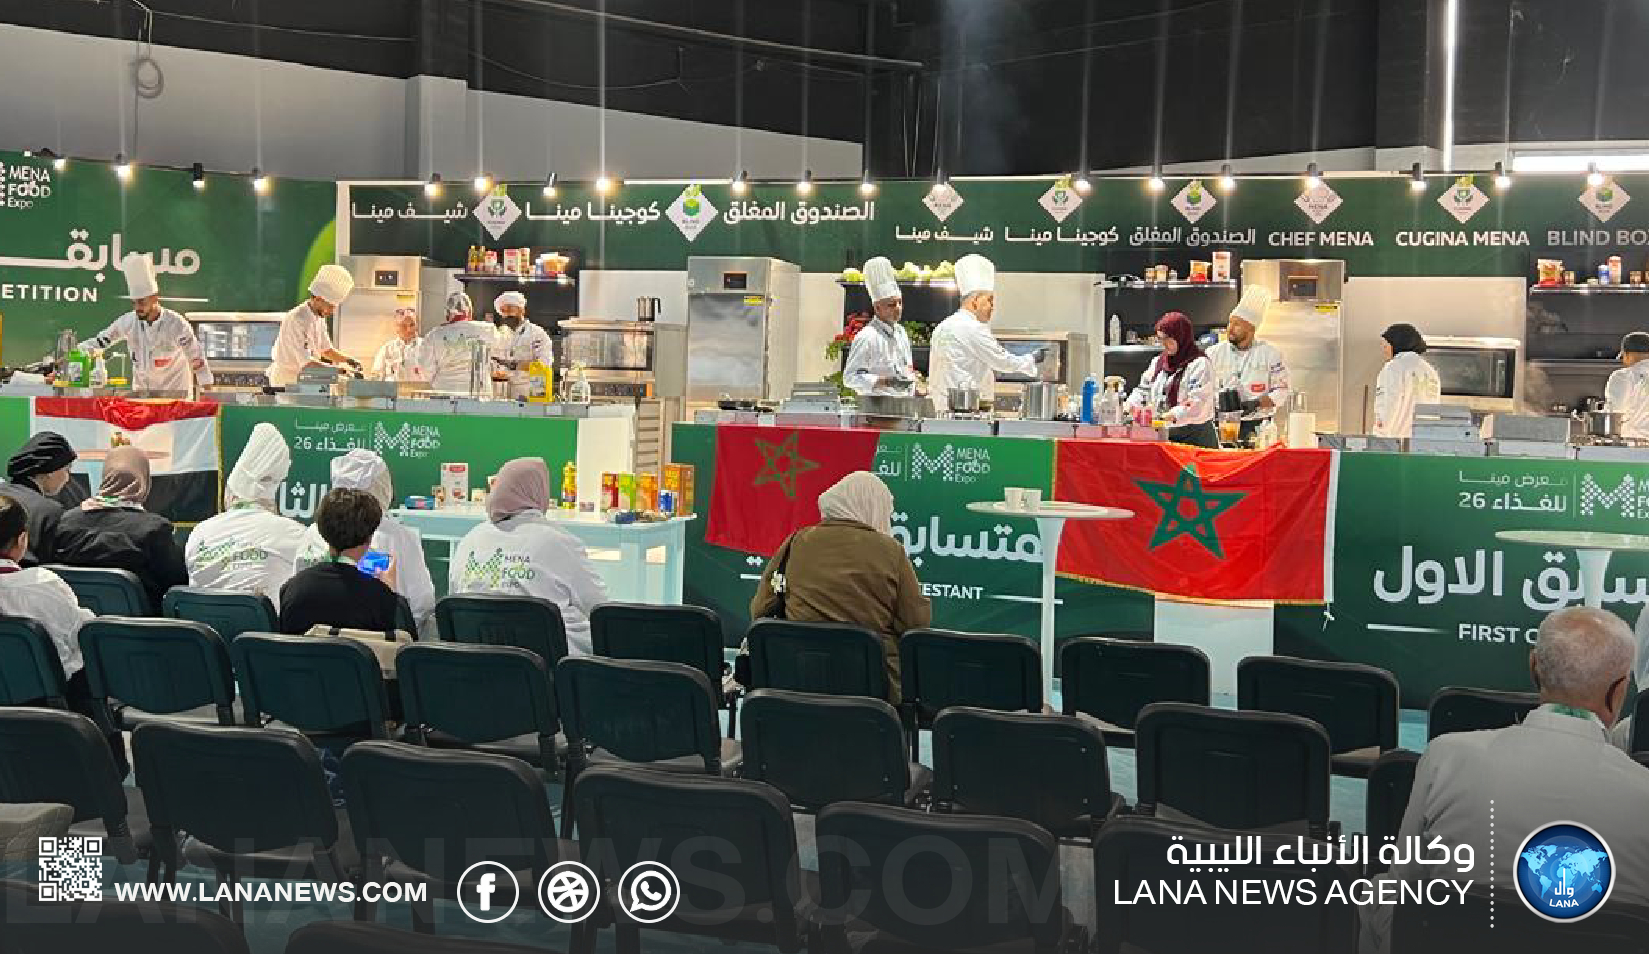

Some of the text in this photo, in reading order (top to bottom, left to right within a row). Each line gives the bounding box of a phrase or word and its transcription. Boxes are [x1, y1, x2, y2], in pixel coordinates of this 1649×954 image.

[9, 165, 51, 182] MENA
[8, 183, 51, 198] FOOD
[7, 198, 33, 210] Expo
[351, 201, 468, 224] شيف مينا
[526, 201, 583, 224] مينا
[587, 201, 661, 225] كوجينا
[723, 201, 786, 225] المغلق
[790, 201, 875, 225] الصندوق
[895, 225, 994, 246] شيف مينا
[1004, 225, 1119, 247] كوجينا مينا
[1129, 225, 1256, 247] الصندوق المغلق
[1268, 231, 1374, 247] CHEF MENA
[1395, 230, 1530, 247] CUGINA MENA
[1547, 229, 1649, 247] BLIND BO
[1, 283, 98, 302] ETITION
[293, 436, 312, 450] 26
[956, 447, 991, 461] MENA
[955, 461, 991, 474] FOOD
[1459, 470, 1568, 488] معرض مينا
[1459, 491, 1567, 512] للغذاء 26
[1373, 545, 1504, 605] الاول
[920, 582, 985, 600] ESTANT
[1458, 623, 1521, 644] FIRST
